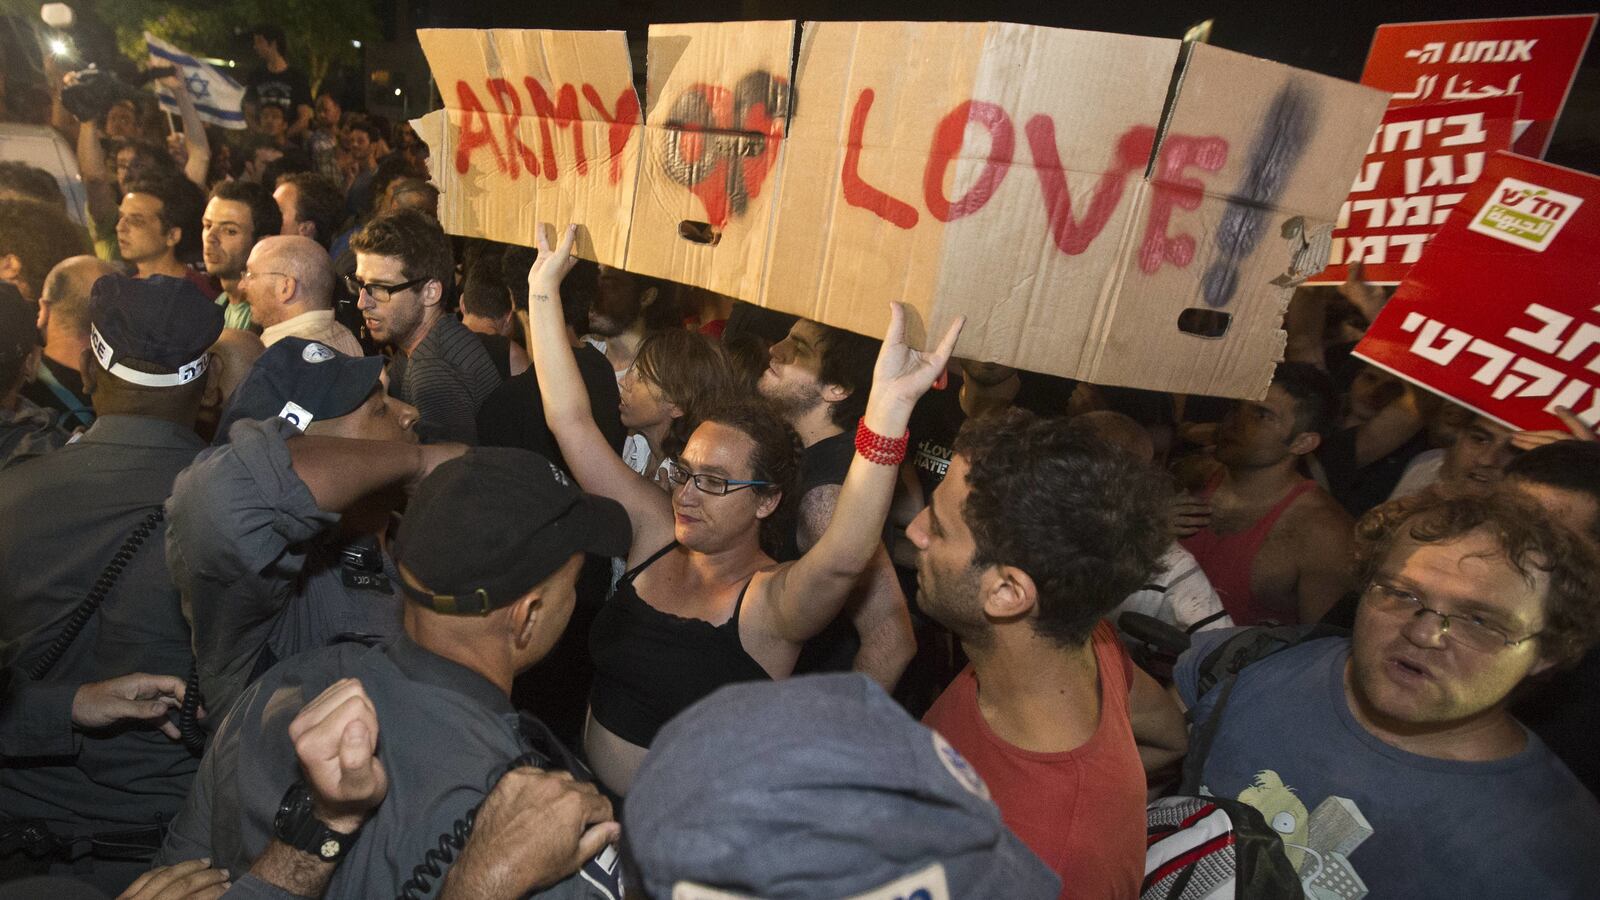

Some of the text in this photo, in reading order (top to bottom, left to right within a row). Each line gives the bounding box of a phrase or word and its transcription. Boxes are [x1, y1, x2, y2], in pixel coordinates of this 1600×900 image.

[1447, 39, 1540, 64] אנחנו
[456, 75, 639, 185] ARMY
[1504, 303, 1600, 374] חב
